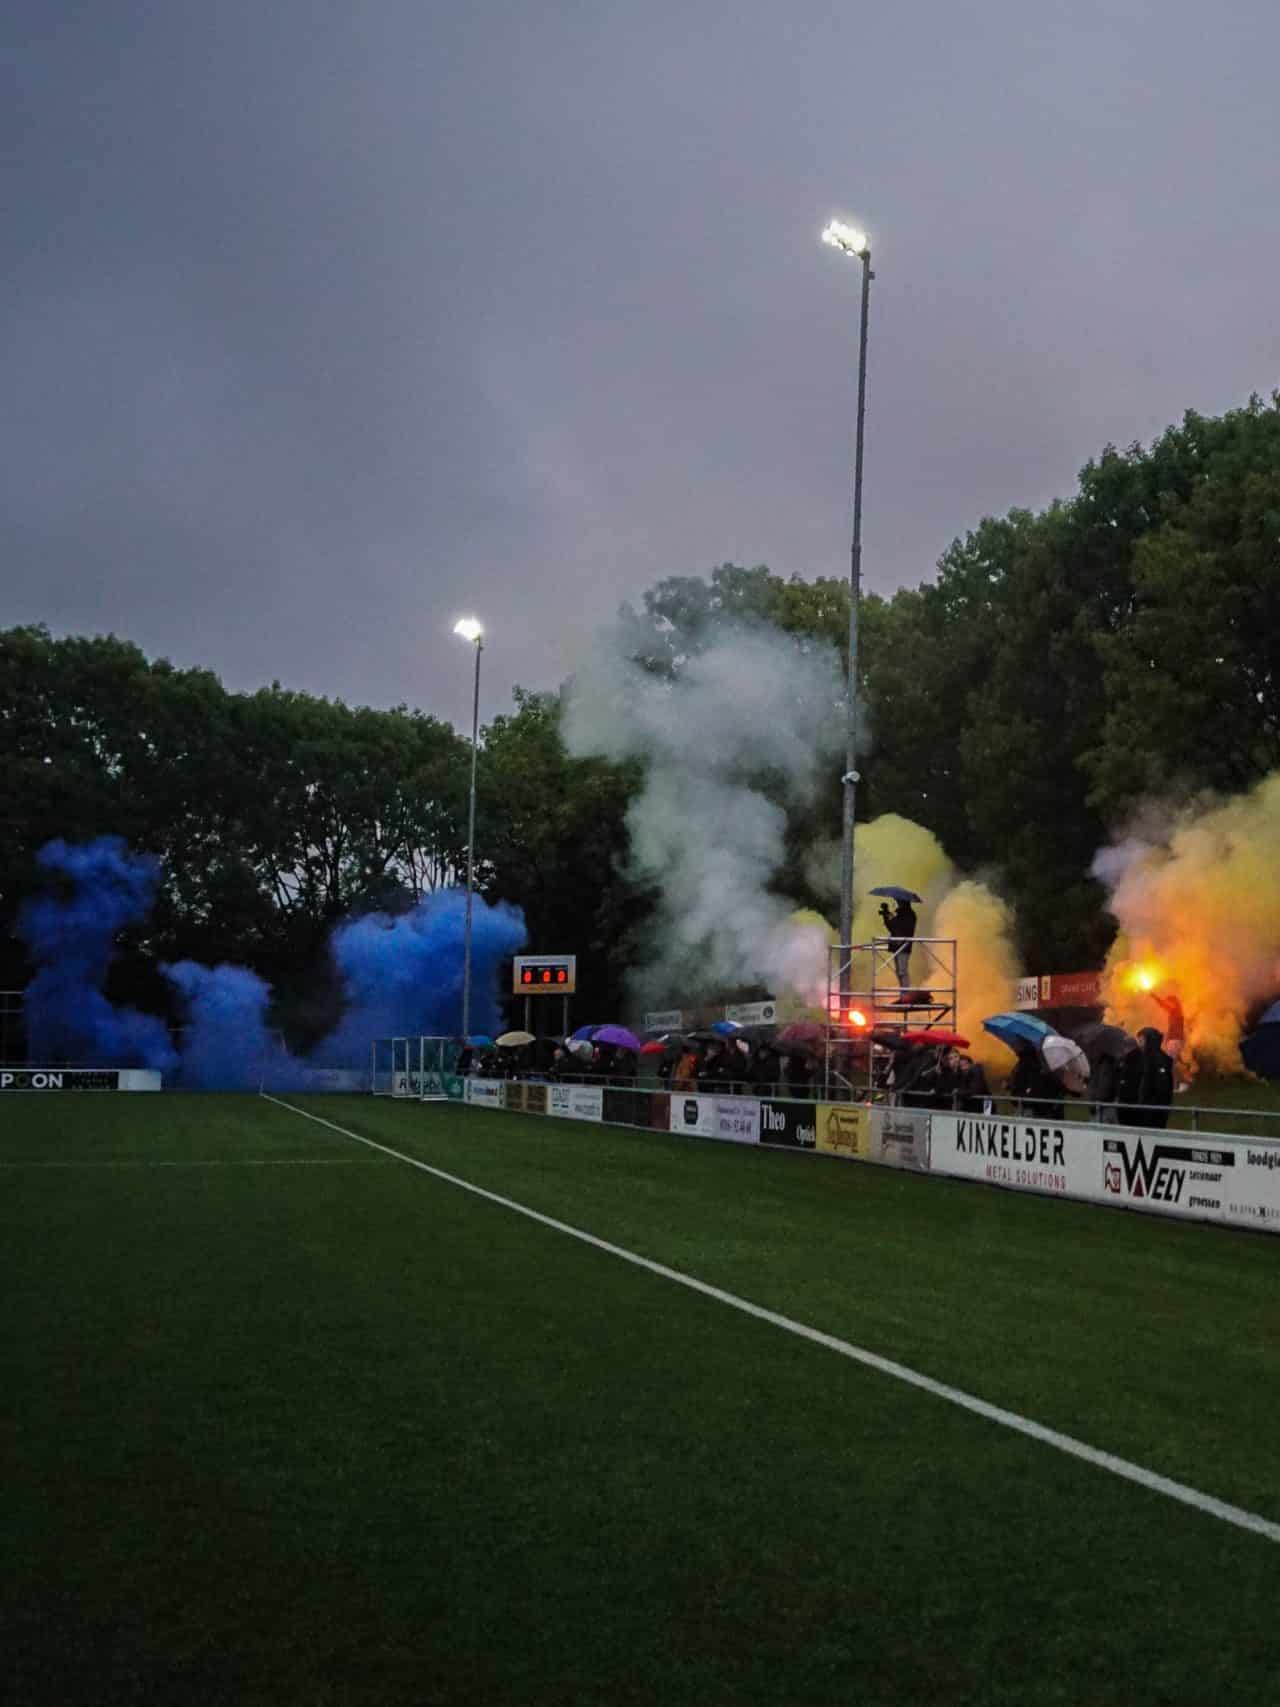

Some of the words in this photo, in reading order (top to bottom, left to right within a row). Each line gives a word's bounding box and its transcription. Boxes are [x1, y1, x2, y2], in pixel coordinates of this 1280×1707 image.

[761, 1104, 786, 1131] Theo
[956, 1119, 1065, 1166] KINKELDER
[986, 1164, 1011, 1181] METAL
[1016, 1170, 1066, 1190] SOLUTIONS
